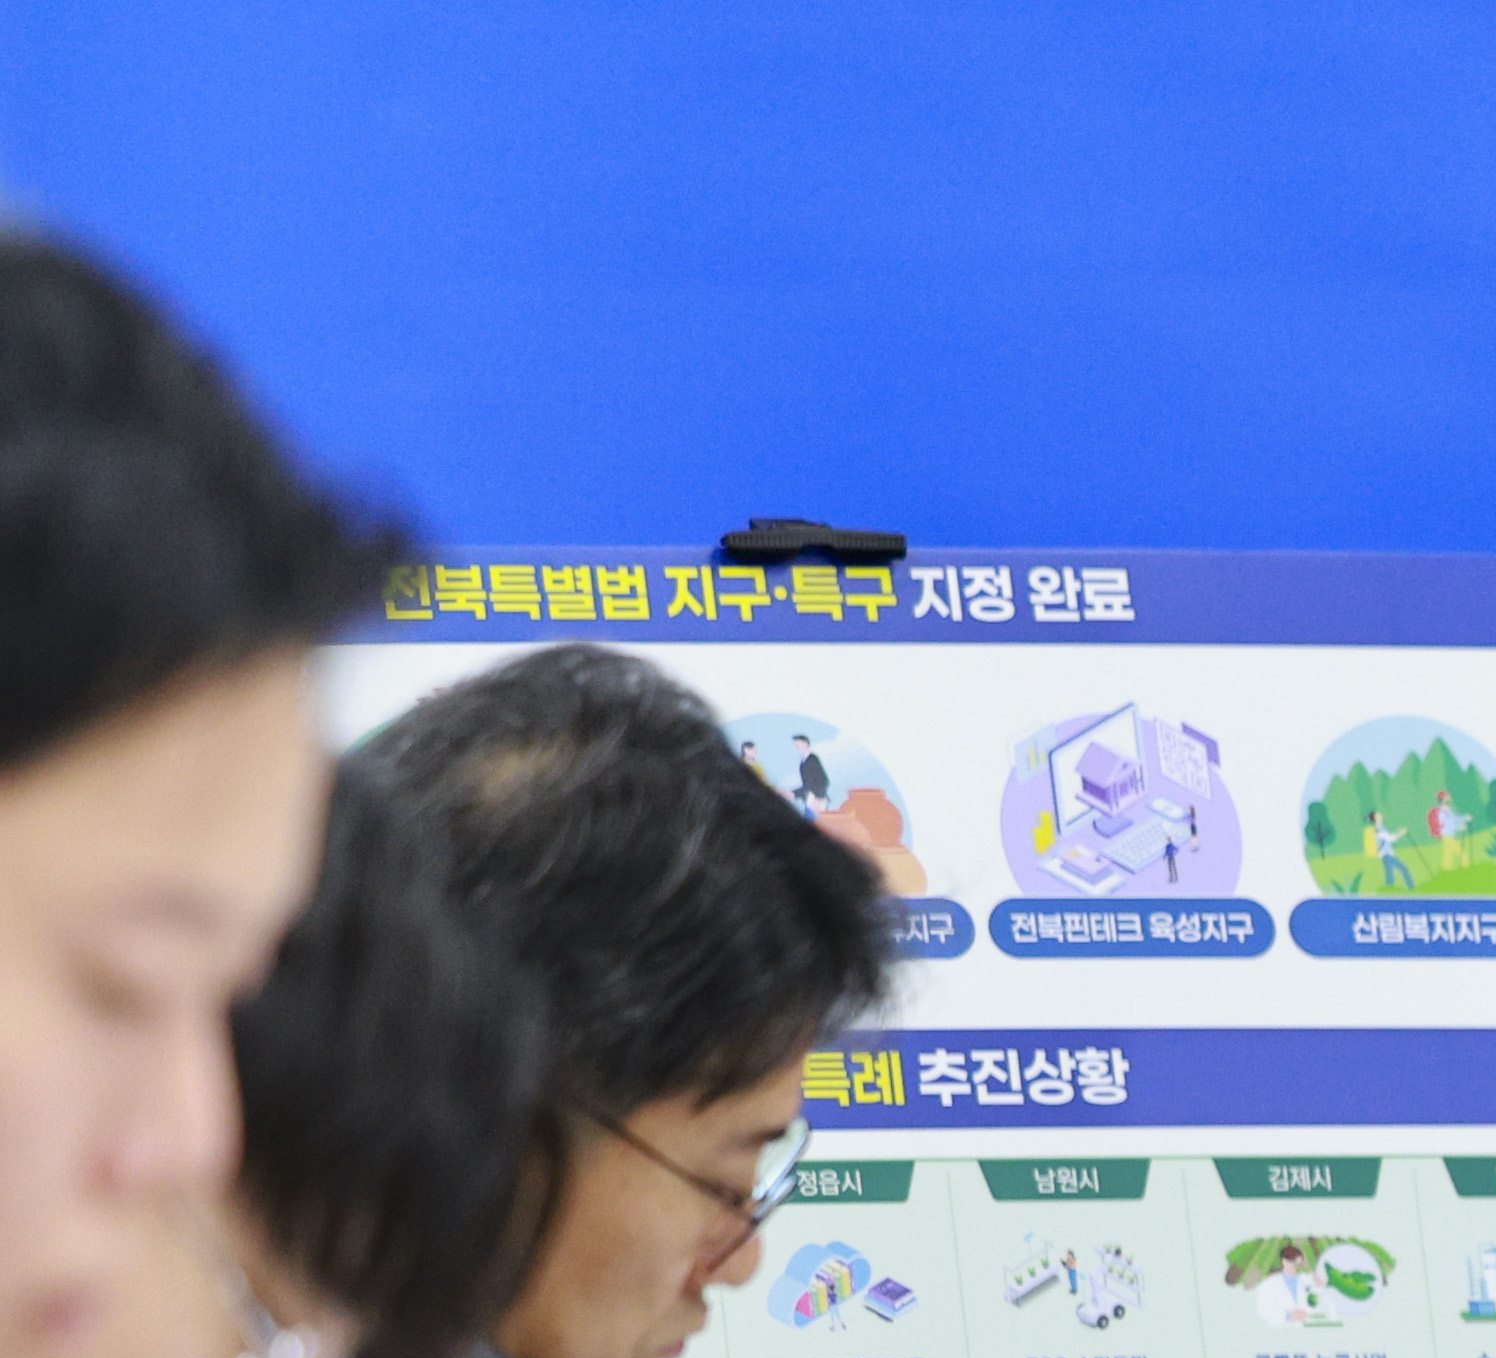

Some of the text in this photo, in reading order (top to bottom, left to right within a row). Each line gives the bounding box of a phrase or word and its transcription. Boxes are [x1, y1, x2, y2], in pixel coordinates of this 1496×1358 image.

[381, 564, 651, 621] 전북특별법
[911, 566, 1016, 622] 지정
[1029, 566, 1136, 622] 완료
[1010, 911, 1255, 944] 전북핀테크 육성지구
[801, 1047, 1130, 1107] 특례 추진상황
[797, 1169, 863, 1196] 정읍시
[1033, 1166, 1100, 1194] 남원시
[1267, 1165, 1333, 1192] 김제시
